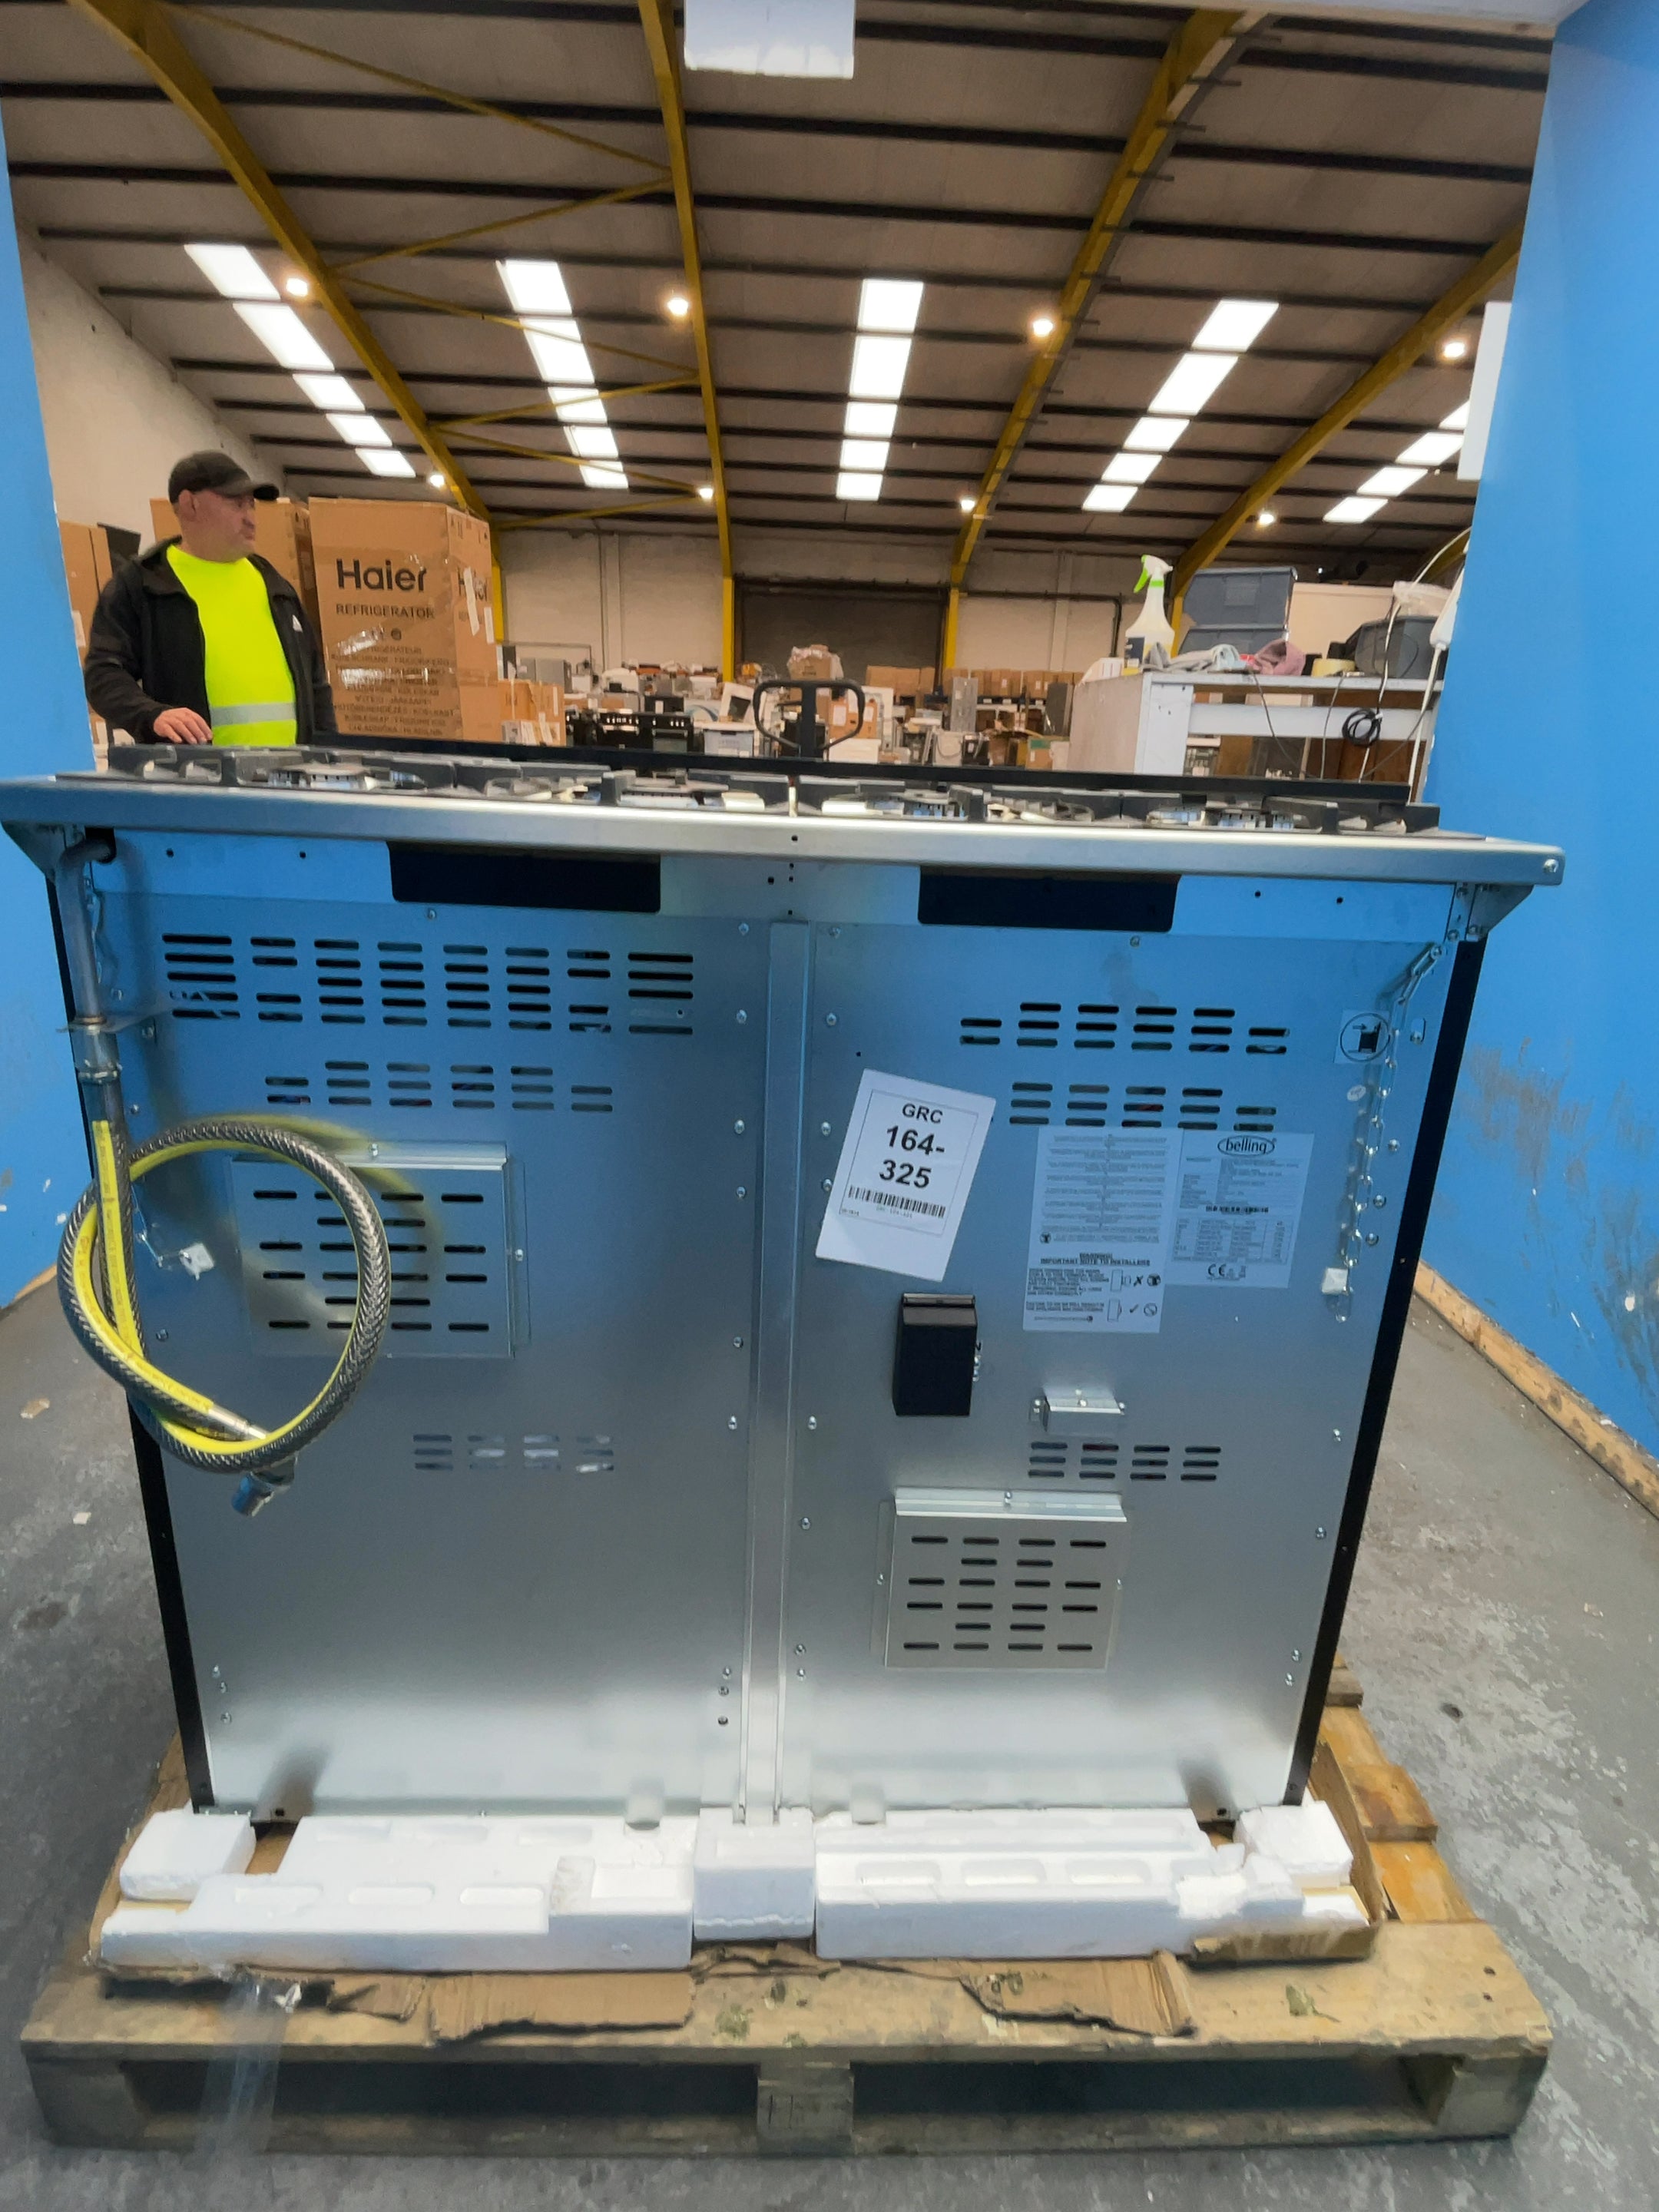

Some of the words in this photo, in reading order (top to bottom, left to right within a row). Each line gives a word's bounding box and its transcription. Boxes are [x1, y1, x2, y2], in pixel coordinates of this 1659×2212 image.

[336, 558, 427, 592] Haier
[336, 603, 435, 619] REFRIGERATOR
[902, 1103, 943, 1124] GRC
[886, 1125, 945, 1155] 164-
[1226, 1137, 1267, 1154] belling
[879, 1160, 932, 1189] 325
